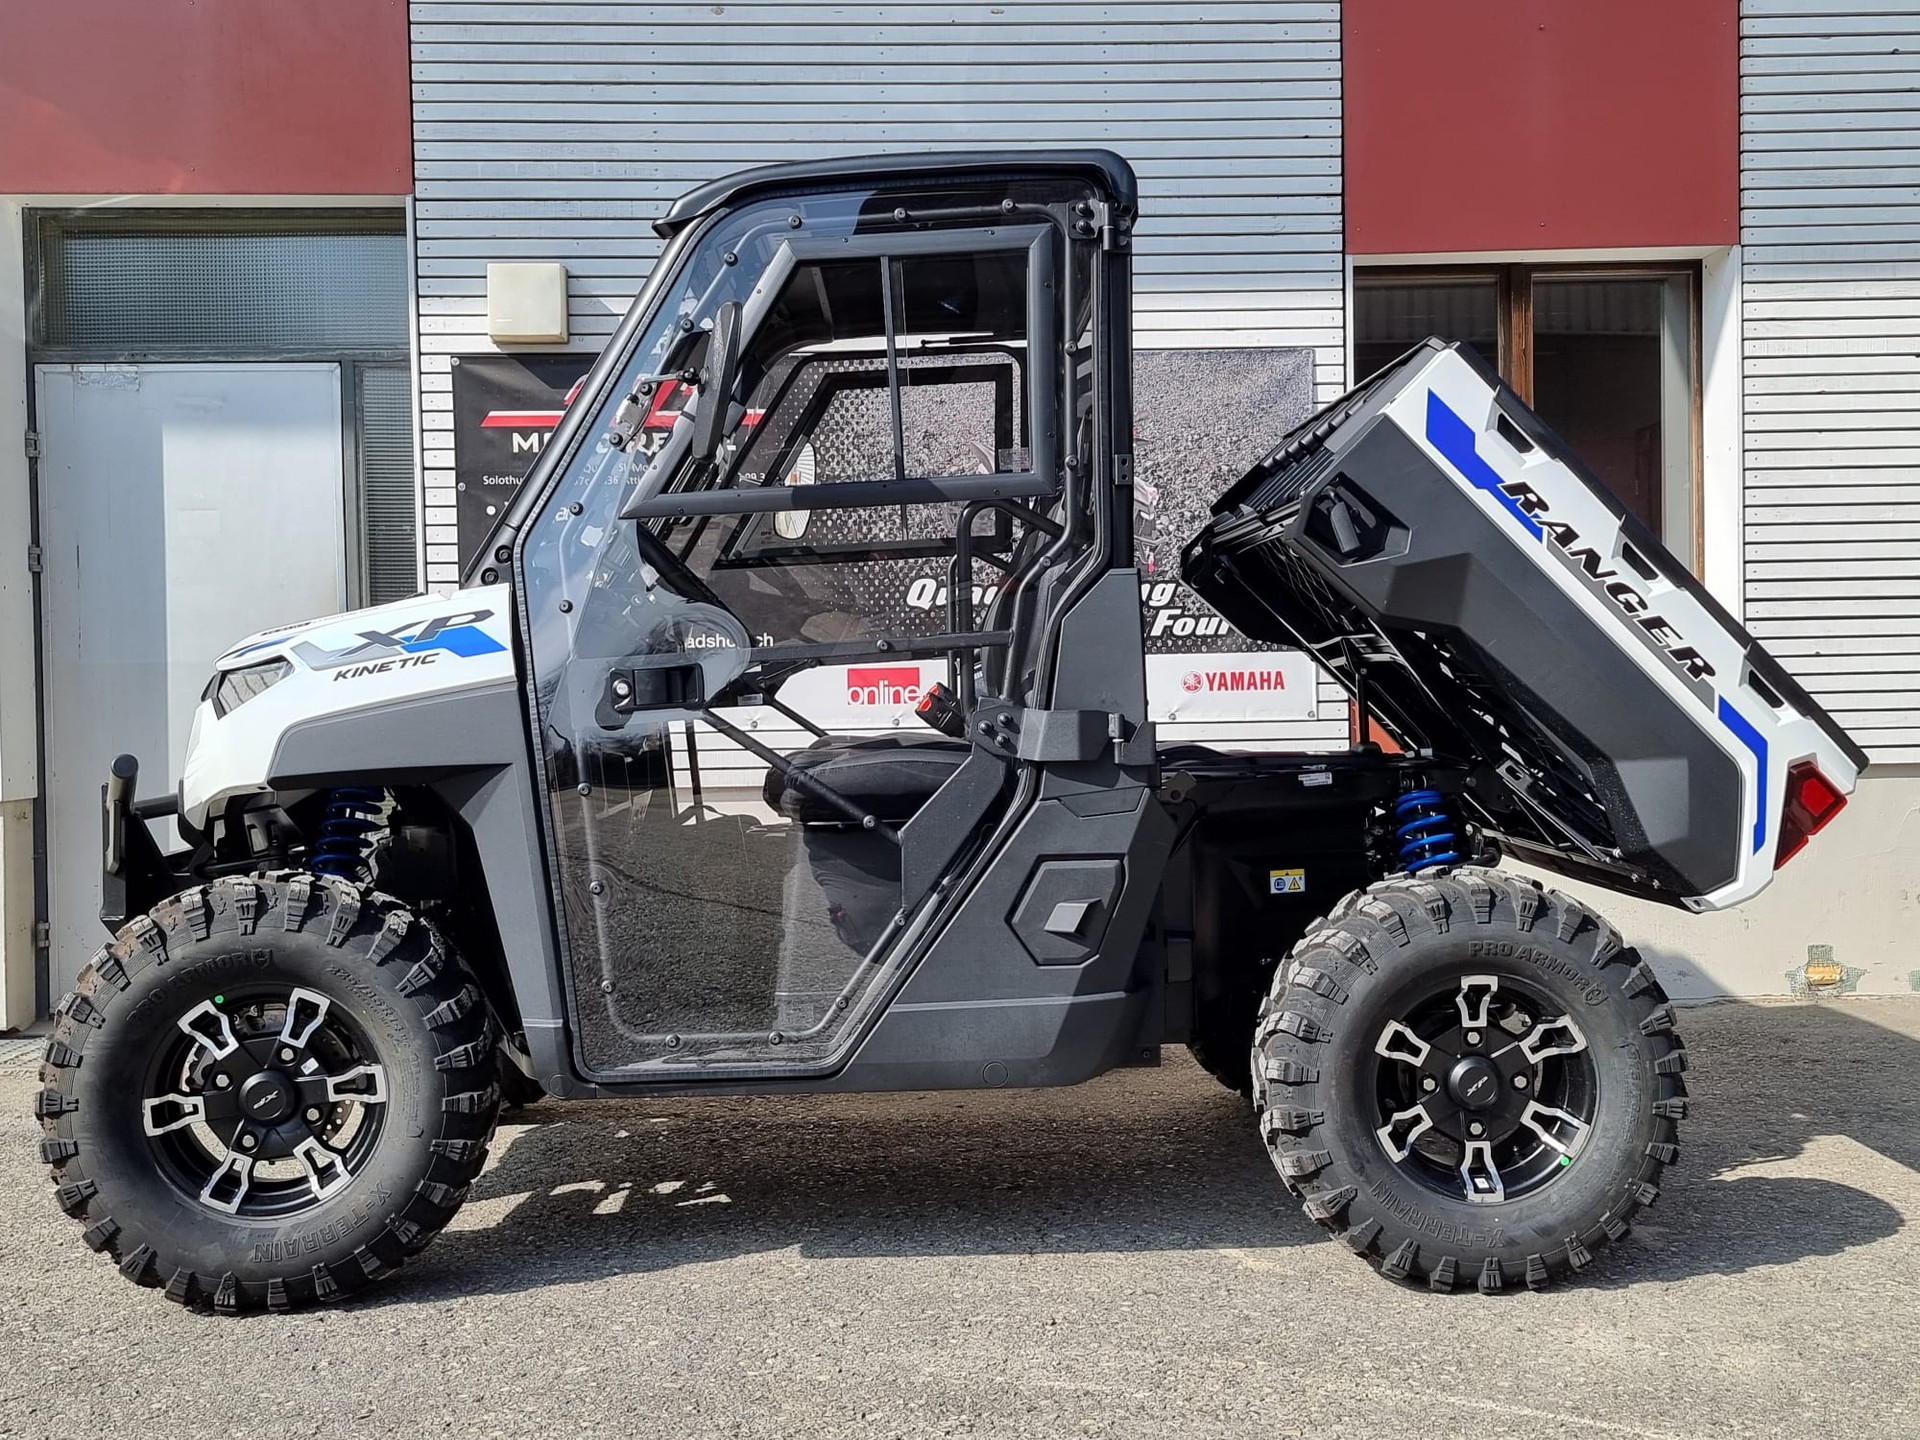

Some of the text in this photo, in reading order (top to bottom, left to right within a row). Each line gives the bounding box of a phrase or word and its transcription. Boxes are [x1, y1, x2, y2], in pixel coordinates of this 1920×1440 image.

[1499, 480, 1717, 682] RANGER
[332, 608, 496, 660] XP
[333, 653, 441, 682] KINETIC
[848, 679, 920, 705] online
[1205, 671, 1285, 691] YAMAHA
[1468, 940, 1591, 992] PRO ARMOR
[252, 1180, 393, 1263] X-TERRAIN
[1370, 1179, 1506, 1249] X-TERRAIN
